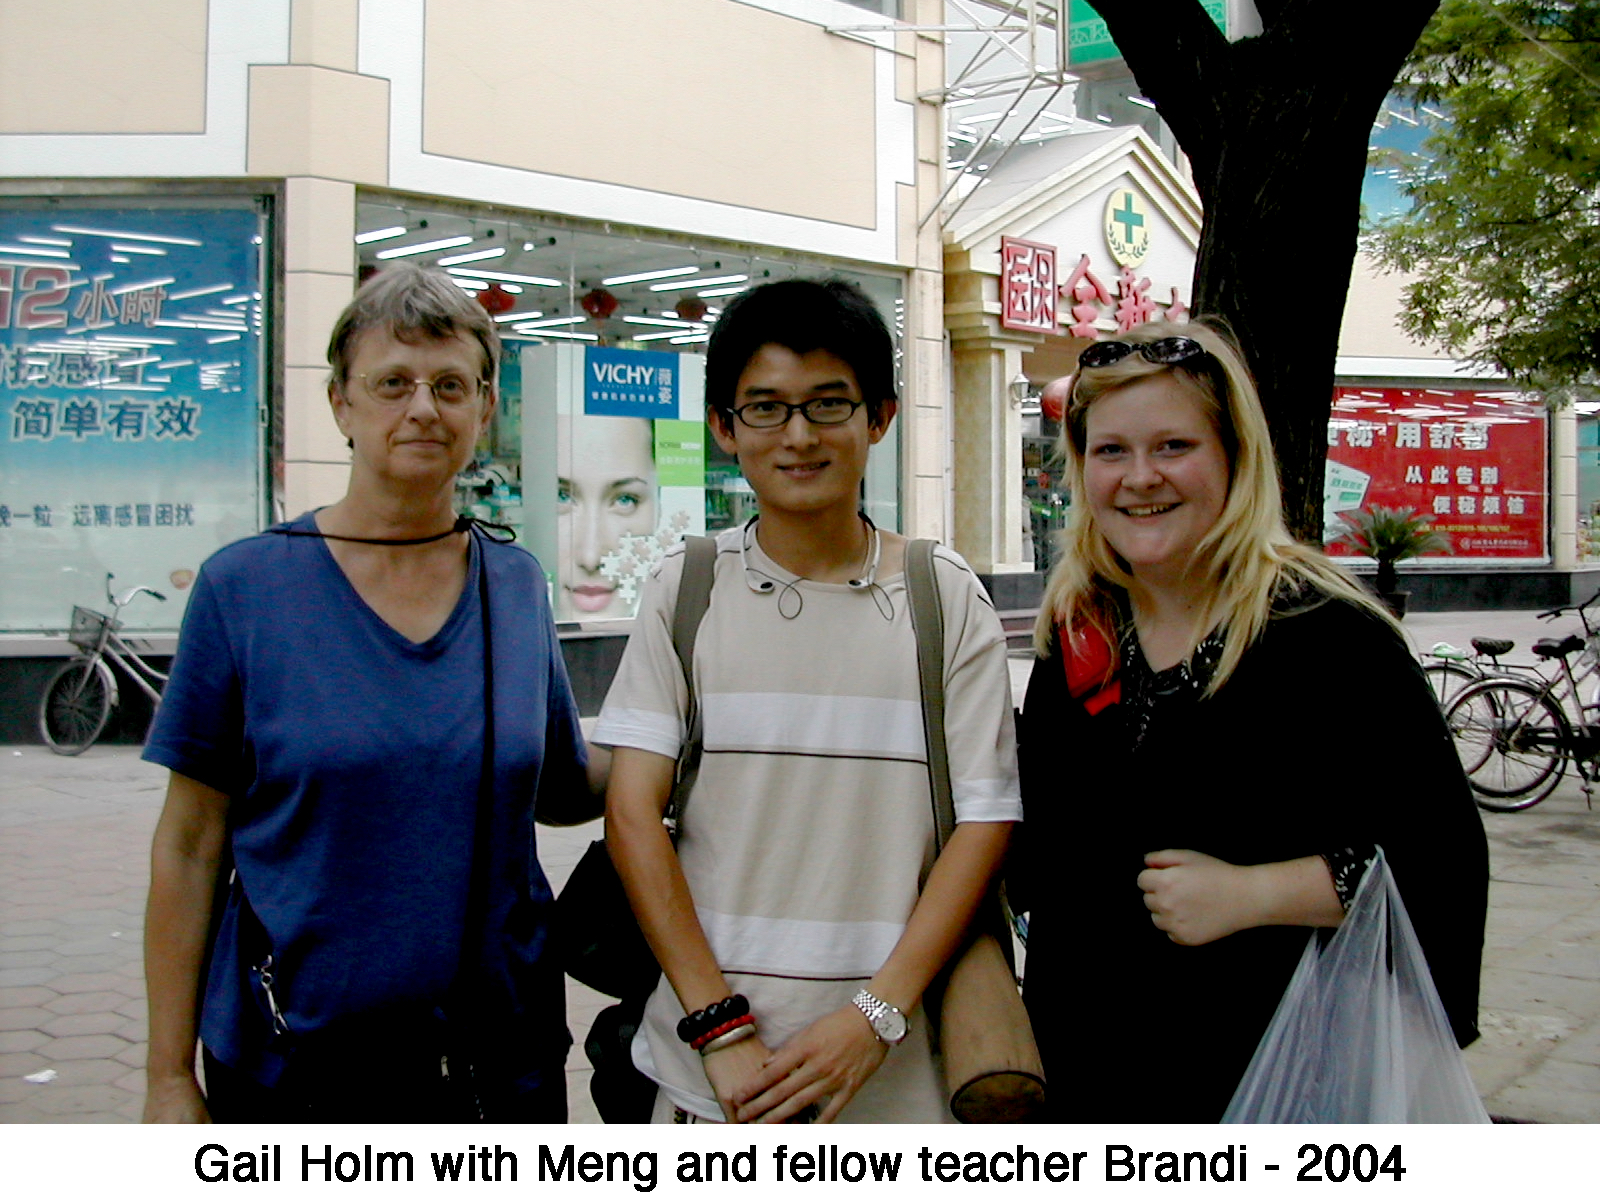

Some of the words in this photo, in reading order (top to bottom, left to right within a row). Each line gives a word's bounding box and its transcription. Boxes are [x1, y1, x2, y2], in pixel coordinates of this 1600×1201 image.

[0, 344, 147, 388] 抗感冒
[592, 362, 654, 386] VICHY
[14, 398, 199, 440] 简单有效
[1404, 465, 1499, 485] 从此告别
[72, 503, 195, 528] 远离感冒困扰
